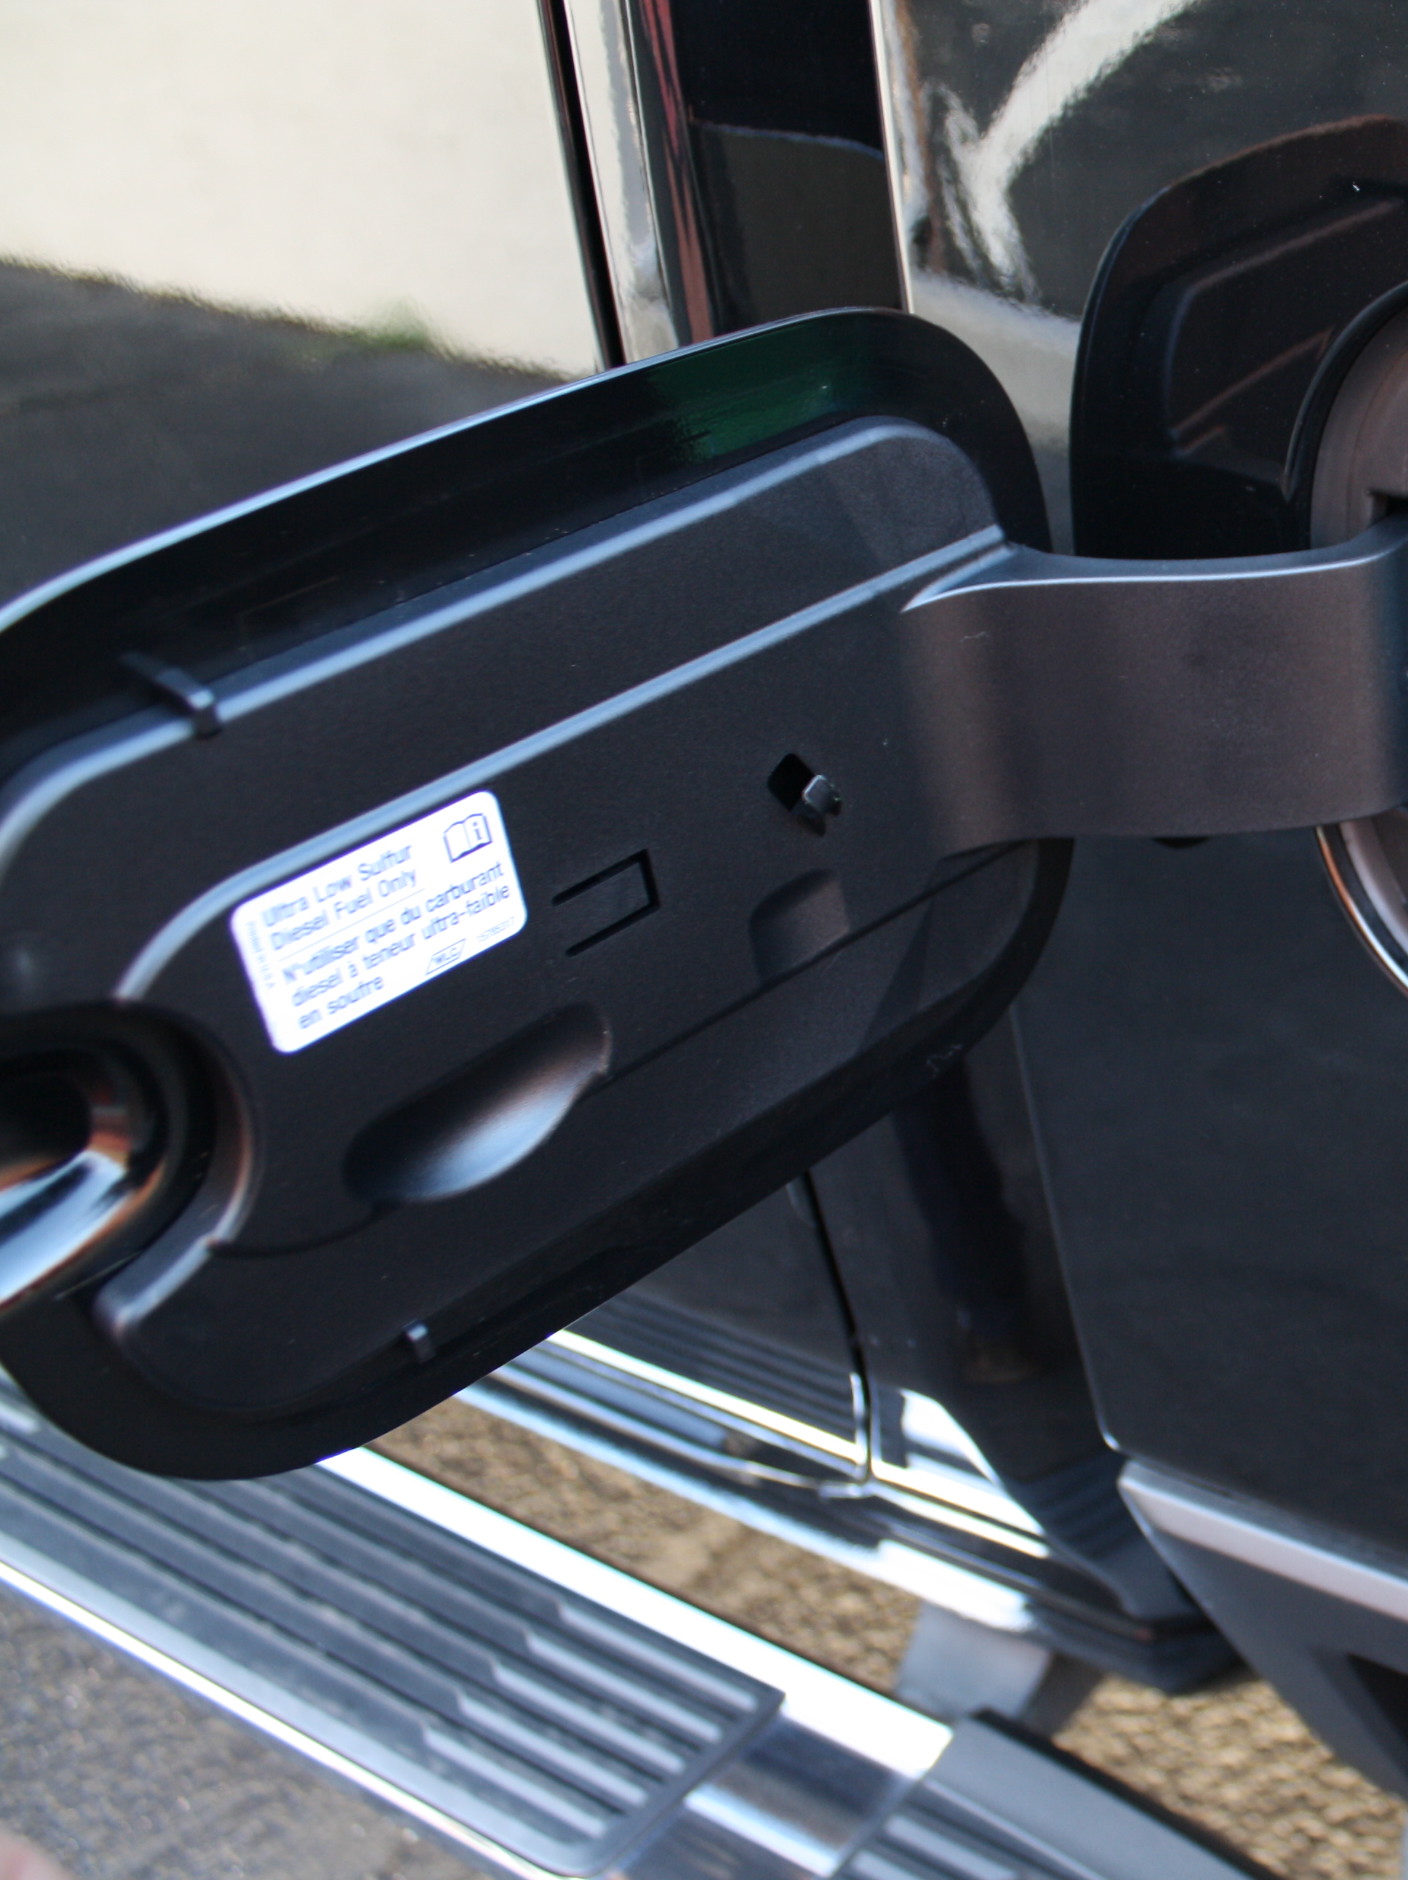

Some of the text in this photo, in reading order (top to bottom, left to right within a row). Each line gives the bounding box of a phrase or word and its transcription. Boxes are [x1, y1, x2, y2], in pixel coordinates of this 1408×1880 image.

[262, 845, 411, 927] Ultra Low Sulfur
[271, 870, 416, 950] Diesel Fuel Only
[366, 919, 397, 943] que
[401, 906, 421, 925] du
[427, 862, 503, 912] carburant
[293, 968, 343, 1006] diesel
[363, 934, 415, 969] teneur
[423, 885, 510, 939] ultra-faible
[299, 977, 384, 1029] en soufre
